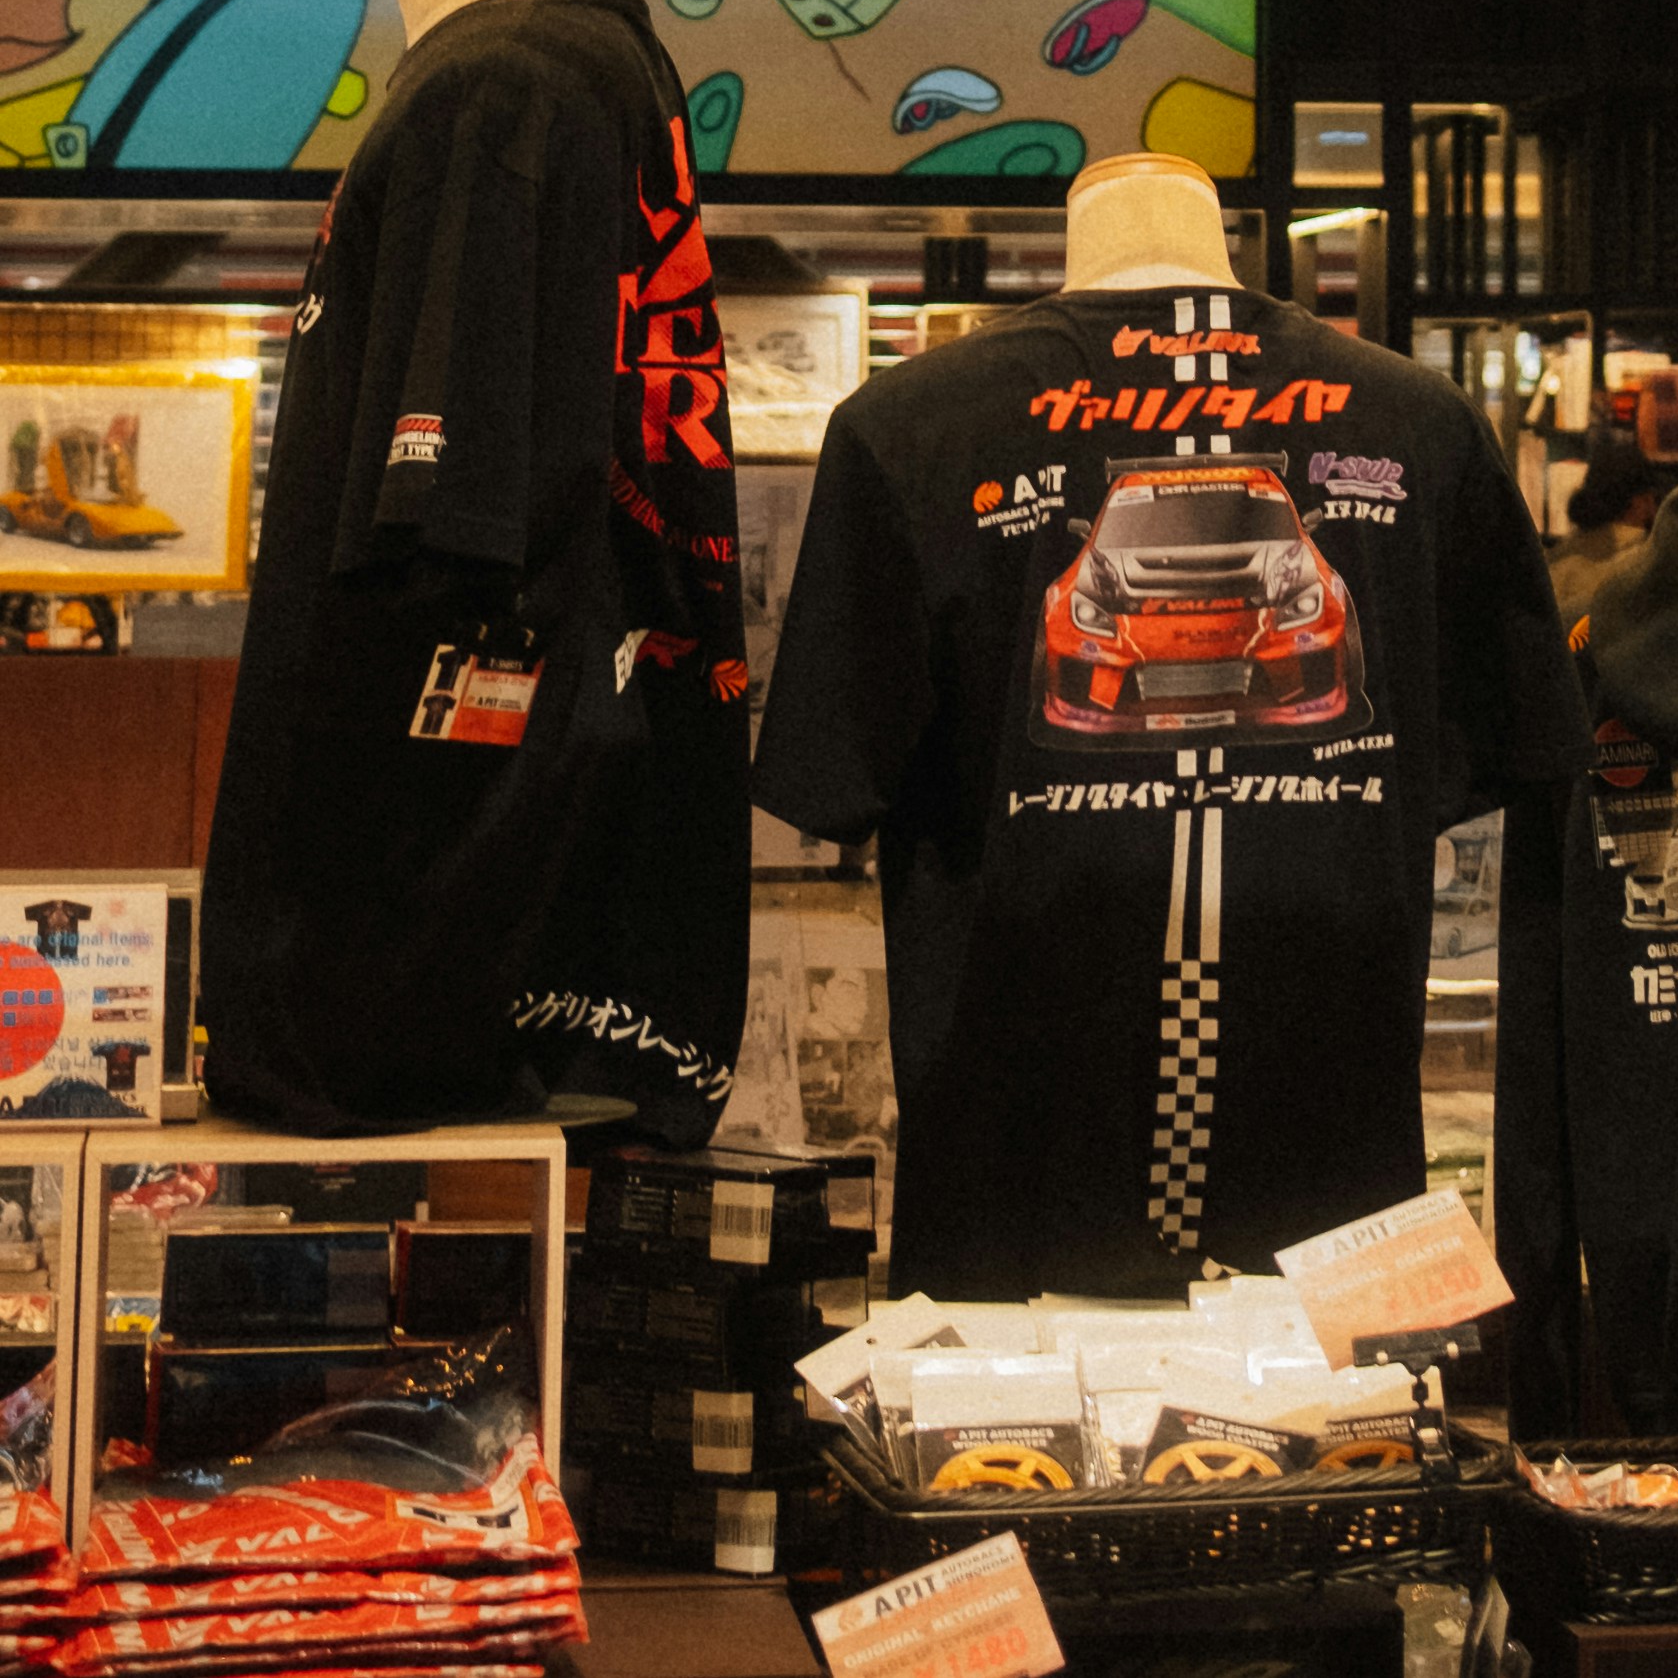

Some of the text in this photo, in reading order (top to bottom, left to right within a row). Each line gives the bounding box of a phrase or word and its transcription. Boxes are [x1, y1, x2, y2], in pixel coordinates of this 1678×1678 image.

[1029, 378, 1353, 432] ヴァリノタイヤ
